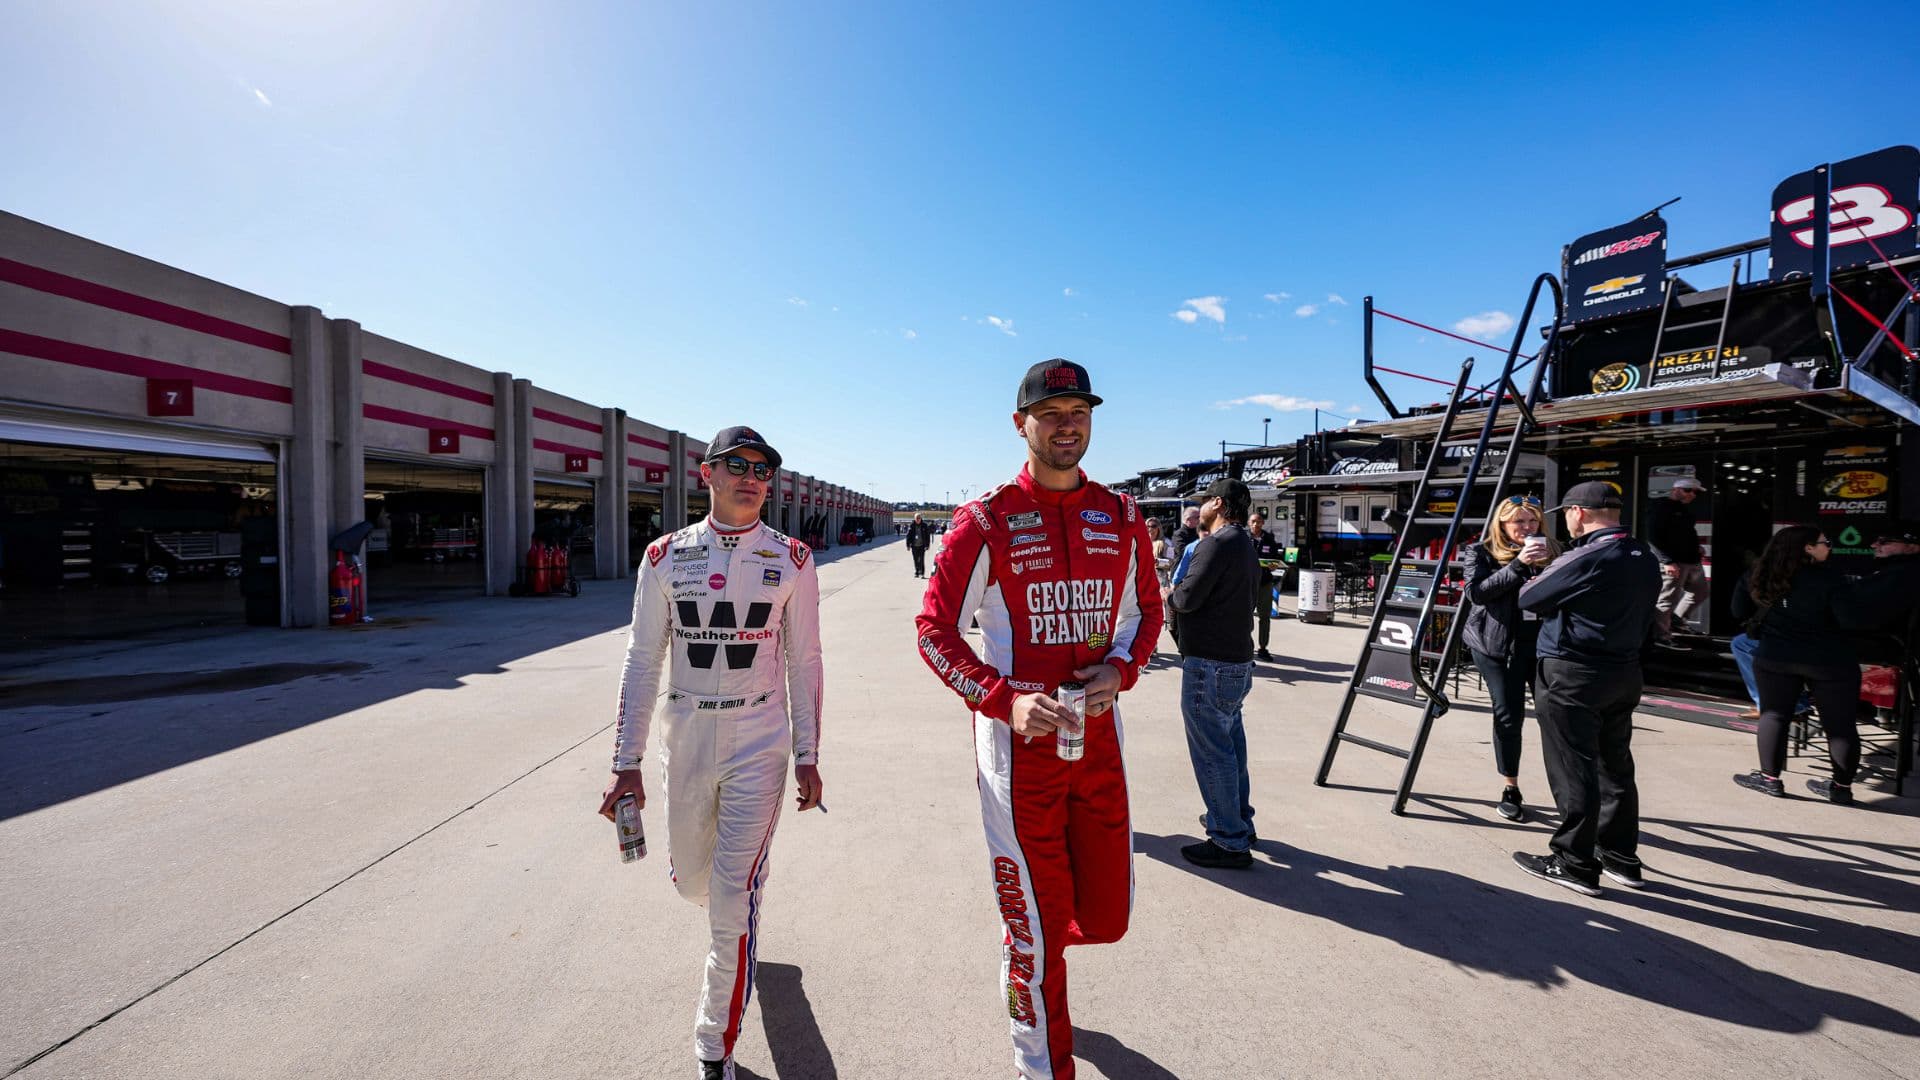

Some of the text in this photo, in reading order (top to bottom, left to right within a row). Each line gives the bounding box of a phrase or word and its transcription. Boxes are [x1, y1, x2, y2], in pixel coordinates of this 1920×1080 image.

[1776, 183, 1913, 249] 3
[1582, 287, 1647, 307] CHEVROLET
[1045, 367, 1077, 378] GEORGIA
[1045, 378, 1078, 389] PEANUTS
[166, 391, 178, 405] 7
[440, 437, 449, 447] 9
[571, 459, 582, 467] 11
[1244, 457, 1284, 469] KAULIG
[1823, 457, 1889, 466] CHEVROLET
[1818, 501, 1888, 510] TRACKER
[1010, 546, 1052, 558] GOODYEAR
[672, 561, 708, 574] Focused
[1026, 578, 1113, 613] GEORGIA
[1311, 579, 1320, 607] CELSIUS
[1028, 609, 1112, 645] PEANUTS
[1379, 620, 1414, 650] 3
[919, 634, 951, 676] GEORGIA
[1009, 679, 1045, 690] sparco
[698, 698, 746, 710] ZANE SMITH
